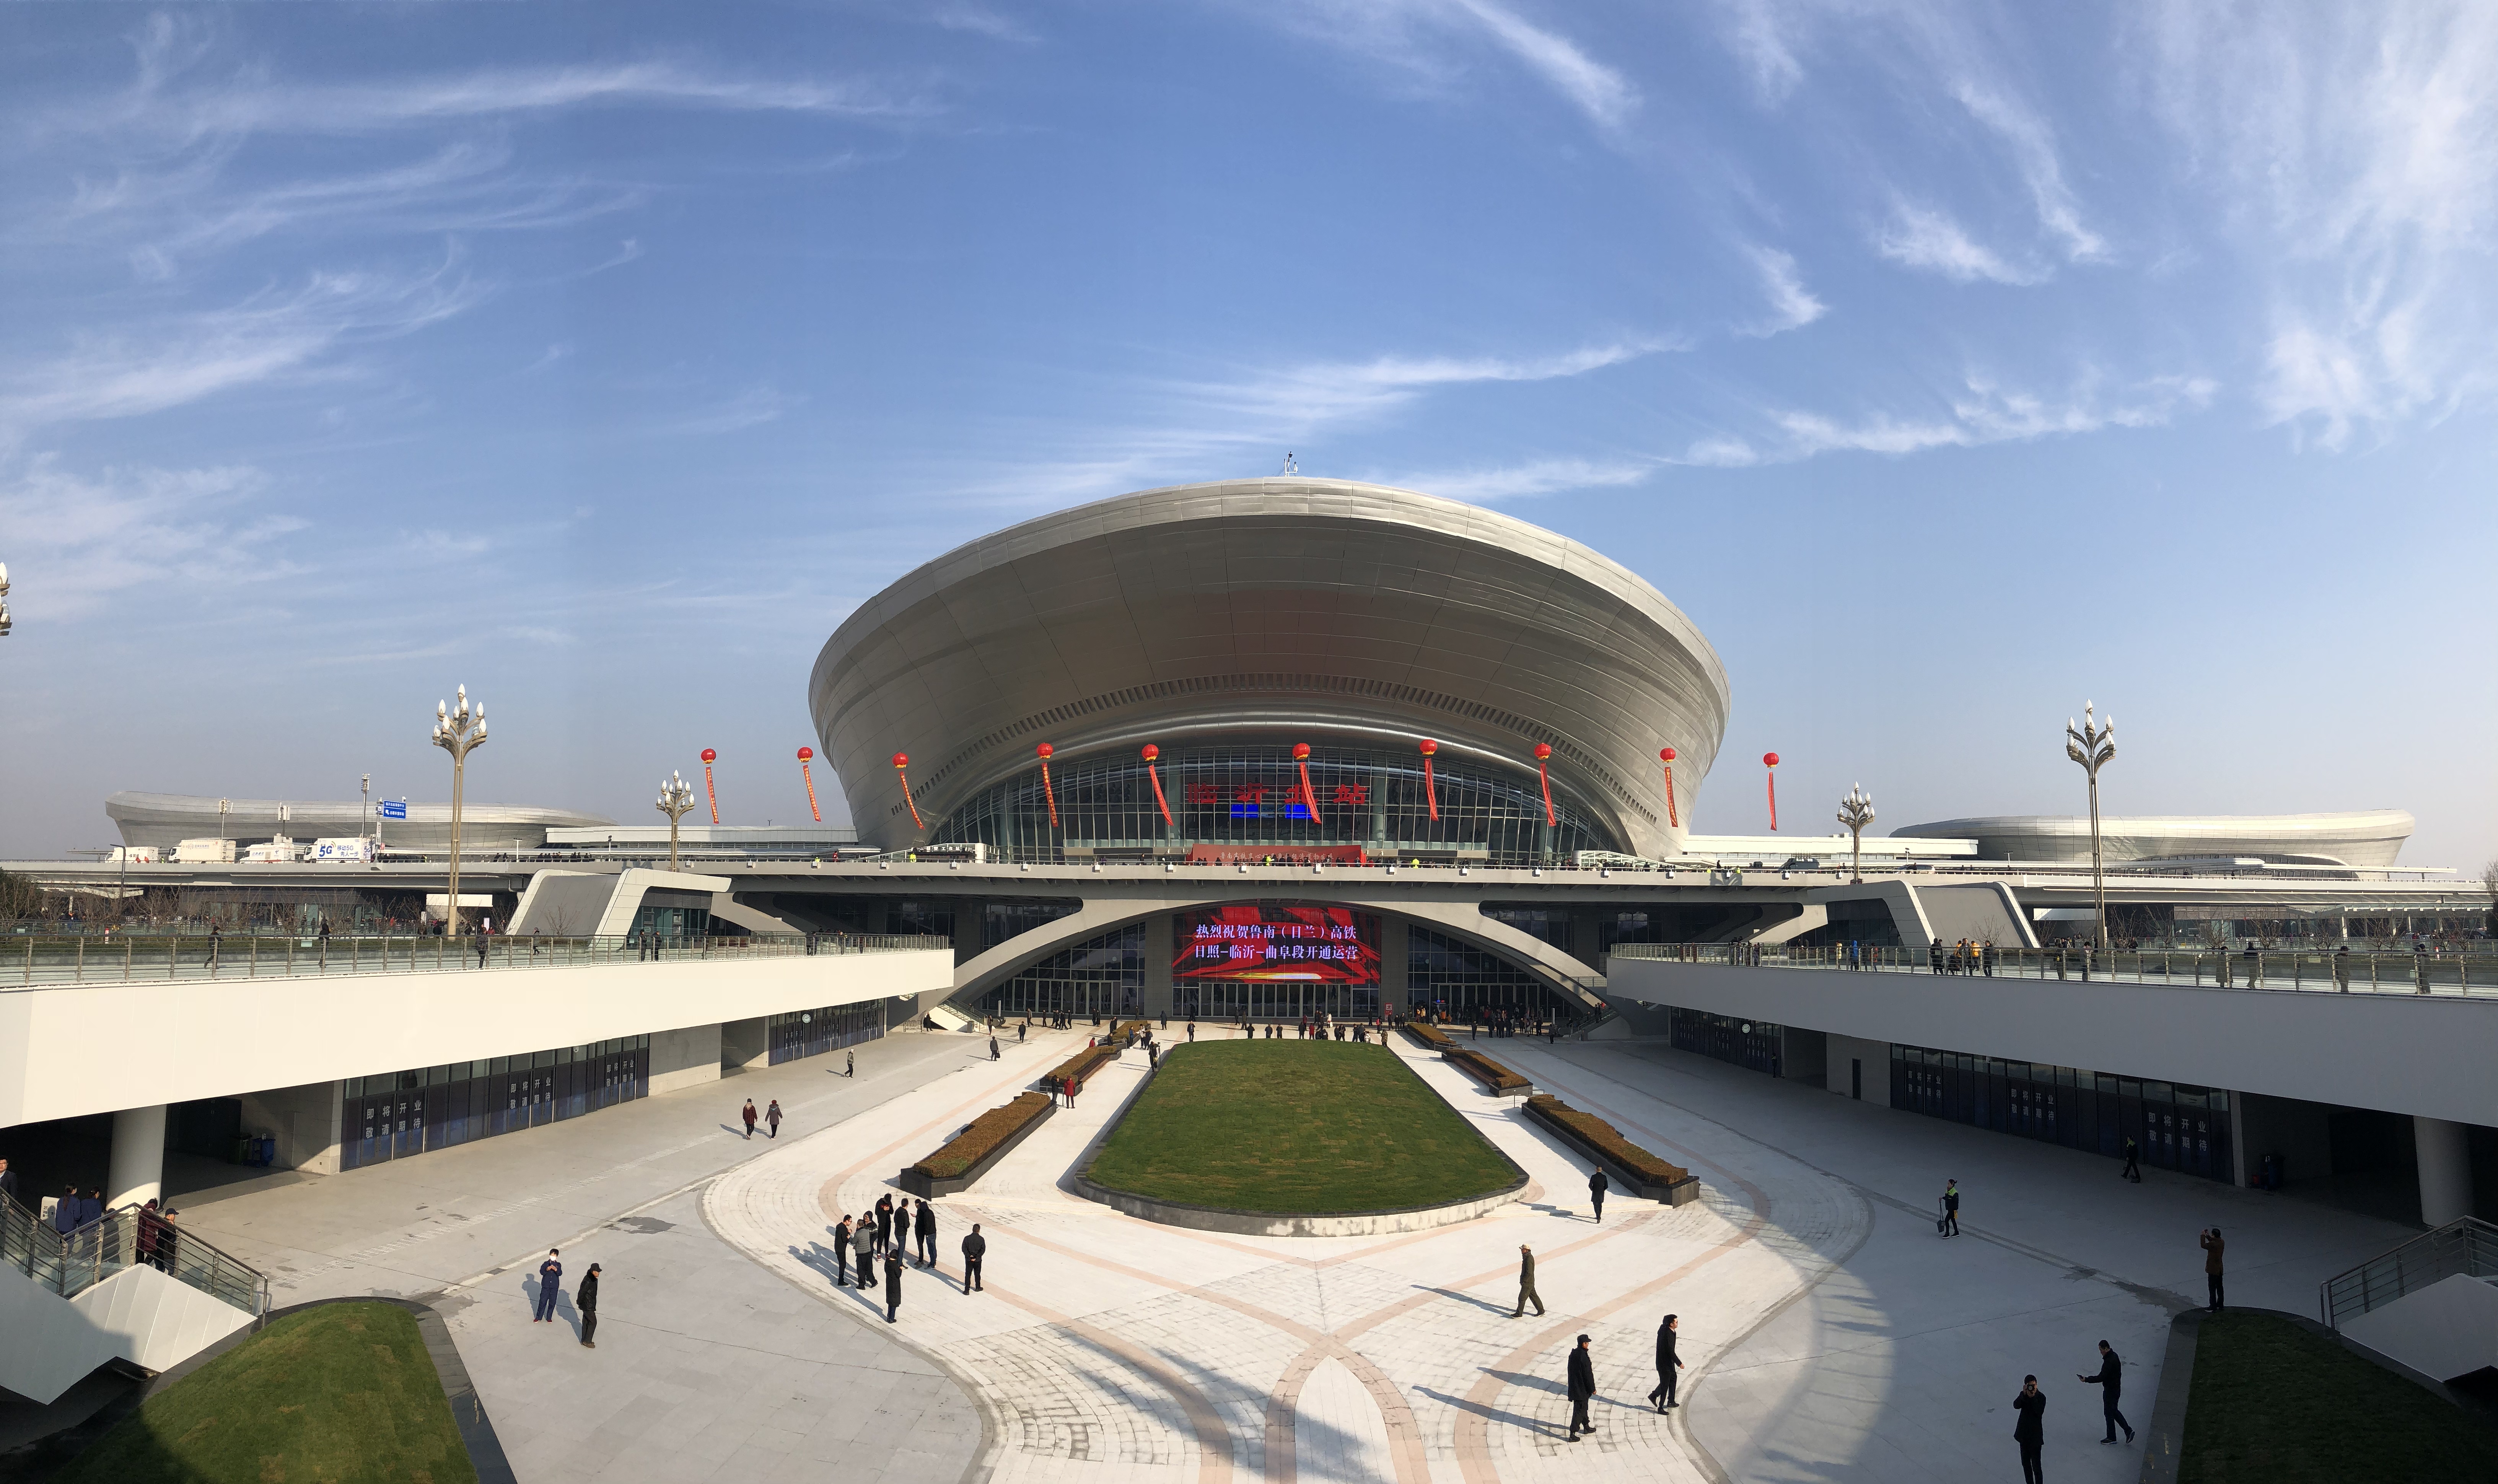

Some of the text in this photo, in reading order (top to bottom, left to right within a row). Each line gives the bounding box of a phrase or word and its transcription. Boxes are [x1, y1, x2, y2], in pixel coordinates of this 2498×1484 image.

[1188, 782, 1368, 804] 临沂北站
[319, 846, 332, 857] 5G
[1196, 924, 1356, 939] 热烈祝贺鲁南（日兰）高铁
[607, 1059, 634, 1073] 即将开业
[511, 1077, 551, 1093] 即将开业
[510, 1092, 550, 1109] 敬请期待
[2011, 1089, 2054, 1105] 即将开业
[366, 1100, 421, 1120] 即将开业
[366, 1117, 421, 1139] 敬请期待
[2148, 1112, 2207, 1133] 即将开业
[2149, 1129, 2207, 1151] 敬请期待
